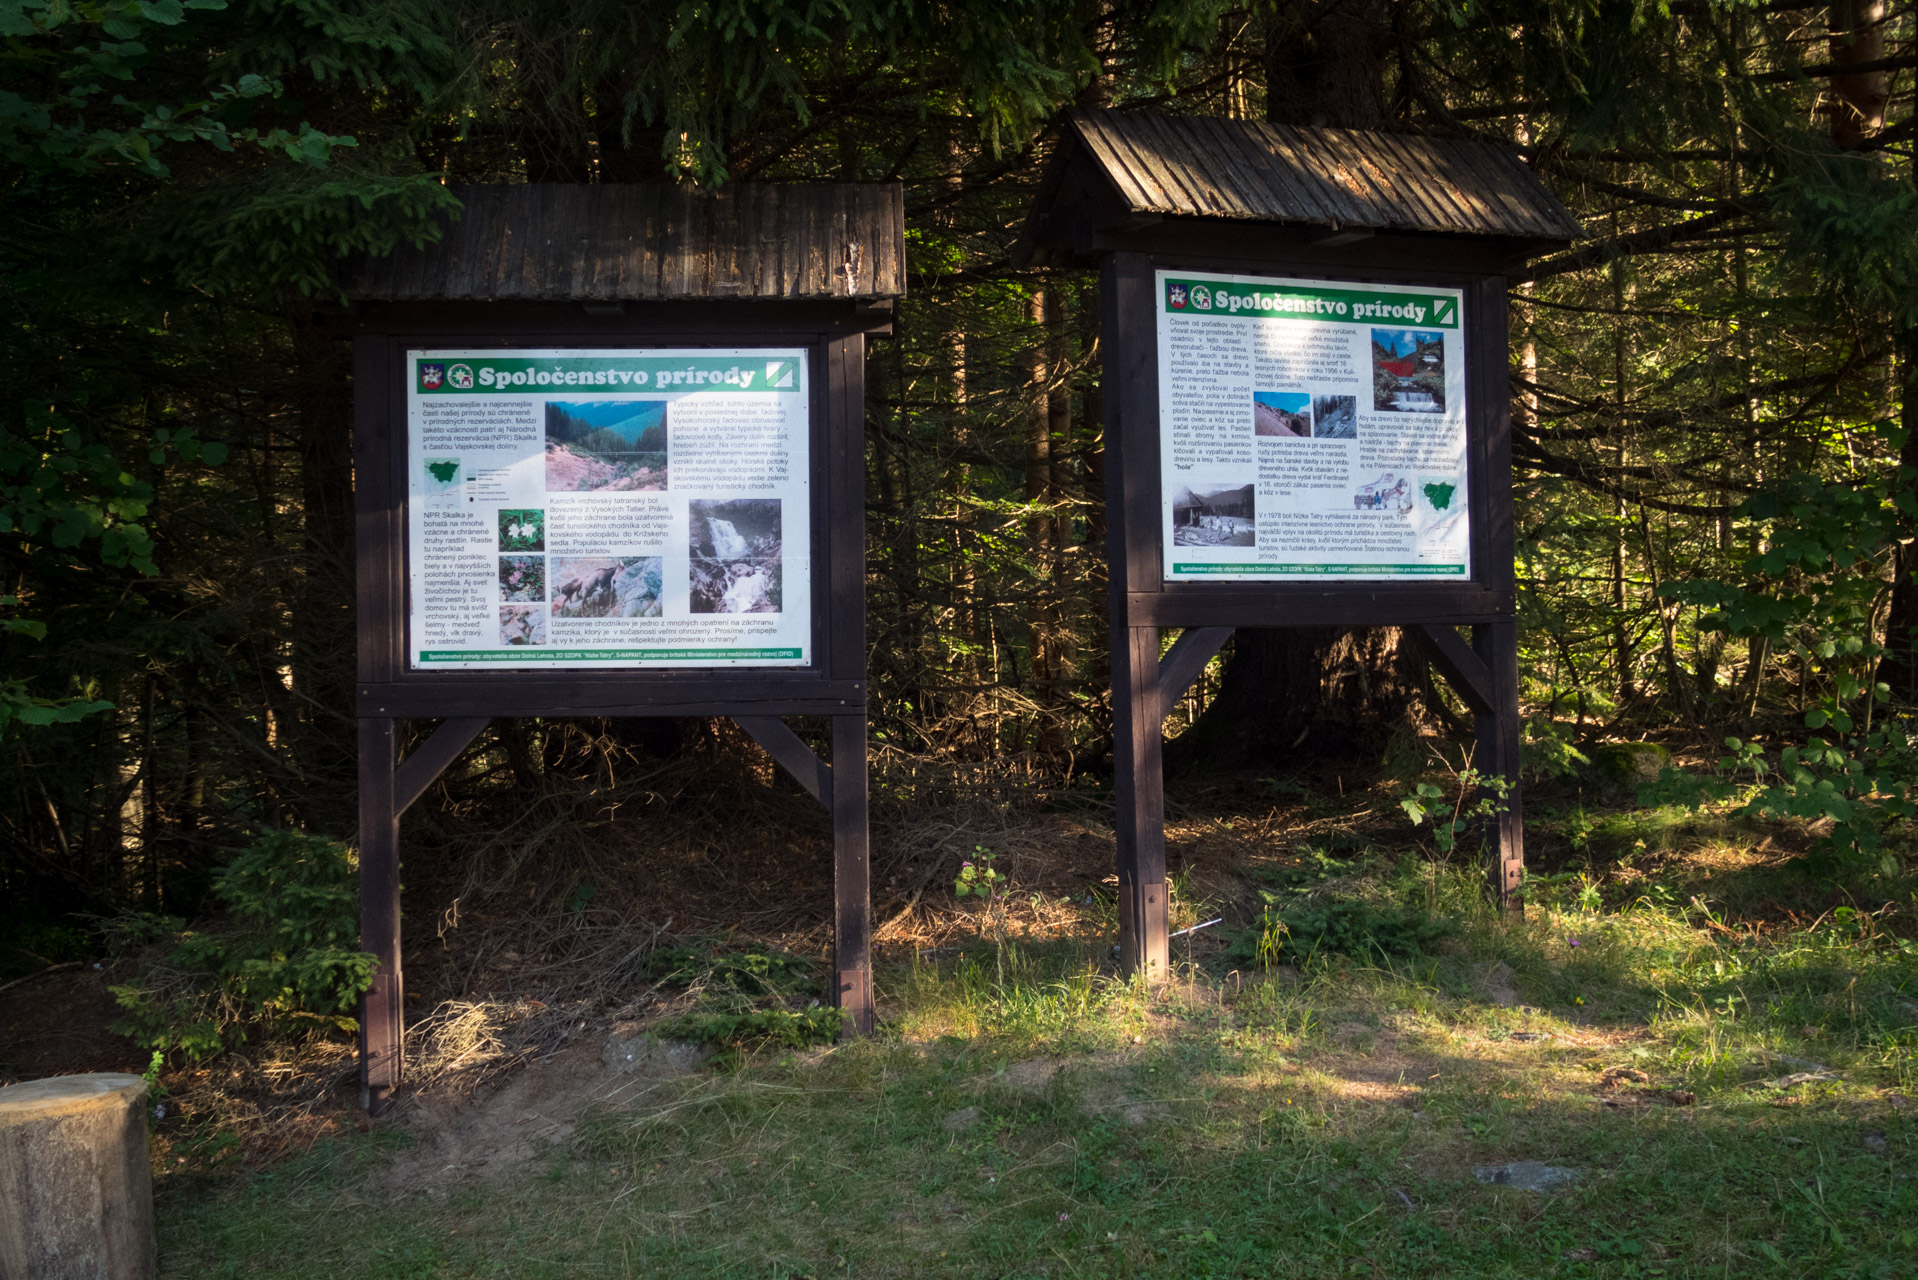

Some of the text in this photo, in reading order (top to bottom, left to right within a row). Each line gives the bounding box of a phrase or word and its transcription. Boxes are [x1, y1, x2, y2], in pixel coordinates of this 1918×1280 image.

[1215, 290, 1348, 317] Spoločenstvo
[1352, 300, 1426, 323] prírody
[478, 366, 648, 389] Spoločenstvo
[656, 366, 756, 388] prírody
[640, 620, 659, 629] jedno
[585, 629, 601, 637] ktorý
